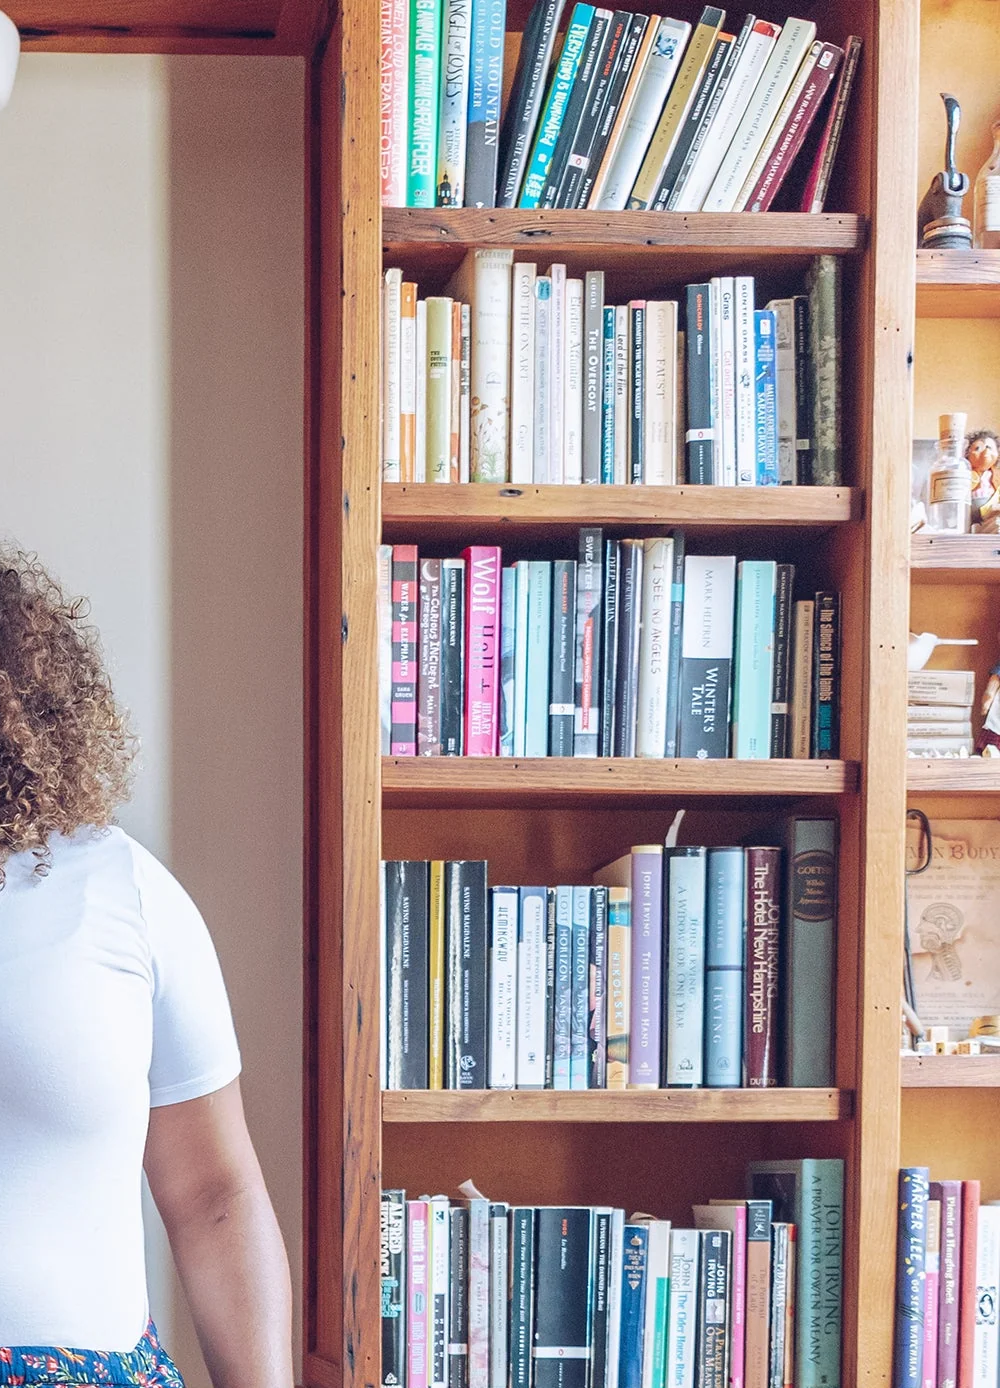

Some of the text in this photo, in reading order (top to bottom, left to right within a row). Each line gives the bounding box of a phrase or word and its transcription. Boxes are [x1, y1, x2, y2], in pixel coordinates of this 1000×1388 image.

[416, 10, 434, 51] ANIMALS
[473, 58, 484, 108] FRAZIER
[484, 2, 502, 146] COLD MOUNTAIN
[532, 43, 547, 81] THE END
[741, 26, 802, 152] our endless numbered days
[411, 142, 431, 176] FOER
[504, 133, 527, 199] NEIL GAIMAN
[721, 292, 732, 321] Grass
[587, 329, 599, 412] THE OVERCOAT
[616, 334, 626, 396] Lord of the Flies
[757, 392, 766, 464] SARAH GRAVES
[585, 536, 593, 590] SWEATER
[399, 583, 409, 677] WATER for ELEPHANTS
[471, 556, 497, 669] Wolf Hall
[819, 624, 834, 651] silence
[820, 653, 834, 661] of
[820, 663, 834, 676] the
[691, 667, 718, 733] WINTER'S TALE
[819, 678, 833, 701] lambs
[471, 701, 492, 737] HILARY MANTEL
[949, 844, 999, 860] BODY
[641, 871, 653, 1048] JOHN IRVING THE FOURTH HAND
[751, 863, 769, 1033] The Hotel New Hampshire
[389, 1201, 403, 1255] ALFRED
[910, 1174, 923, 1261] HARPER LEE
[681, 1258, 693, 1287] JOHN
[808, 1175, 822, 1365] A PRAYER FOR OWEN MEANY
[823, 1204, 840, 1336] JOHN IRVING
[944, 1196, 955, 1305] Picnic at Hanging Rock
[707, 1259, 725, 1298] JOHN IRVING
[911, 1279, 919, 1292] GO
[674, 1295, 687, 1387] The Cider House Rules
[908, 1325, 918, 1378] WATCHMAN
